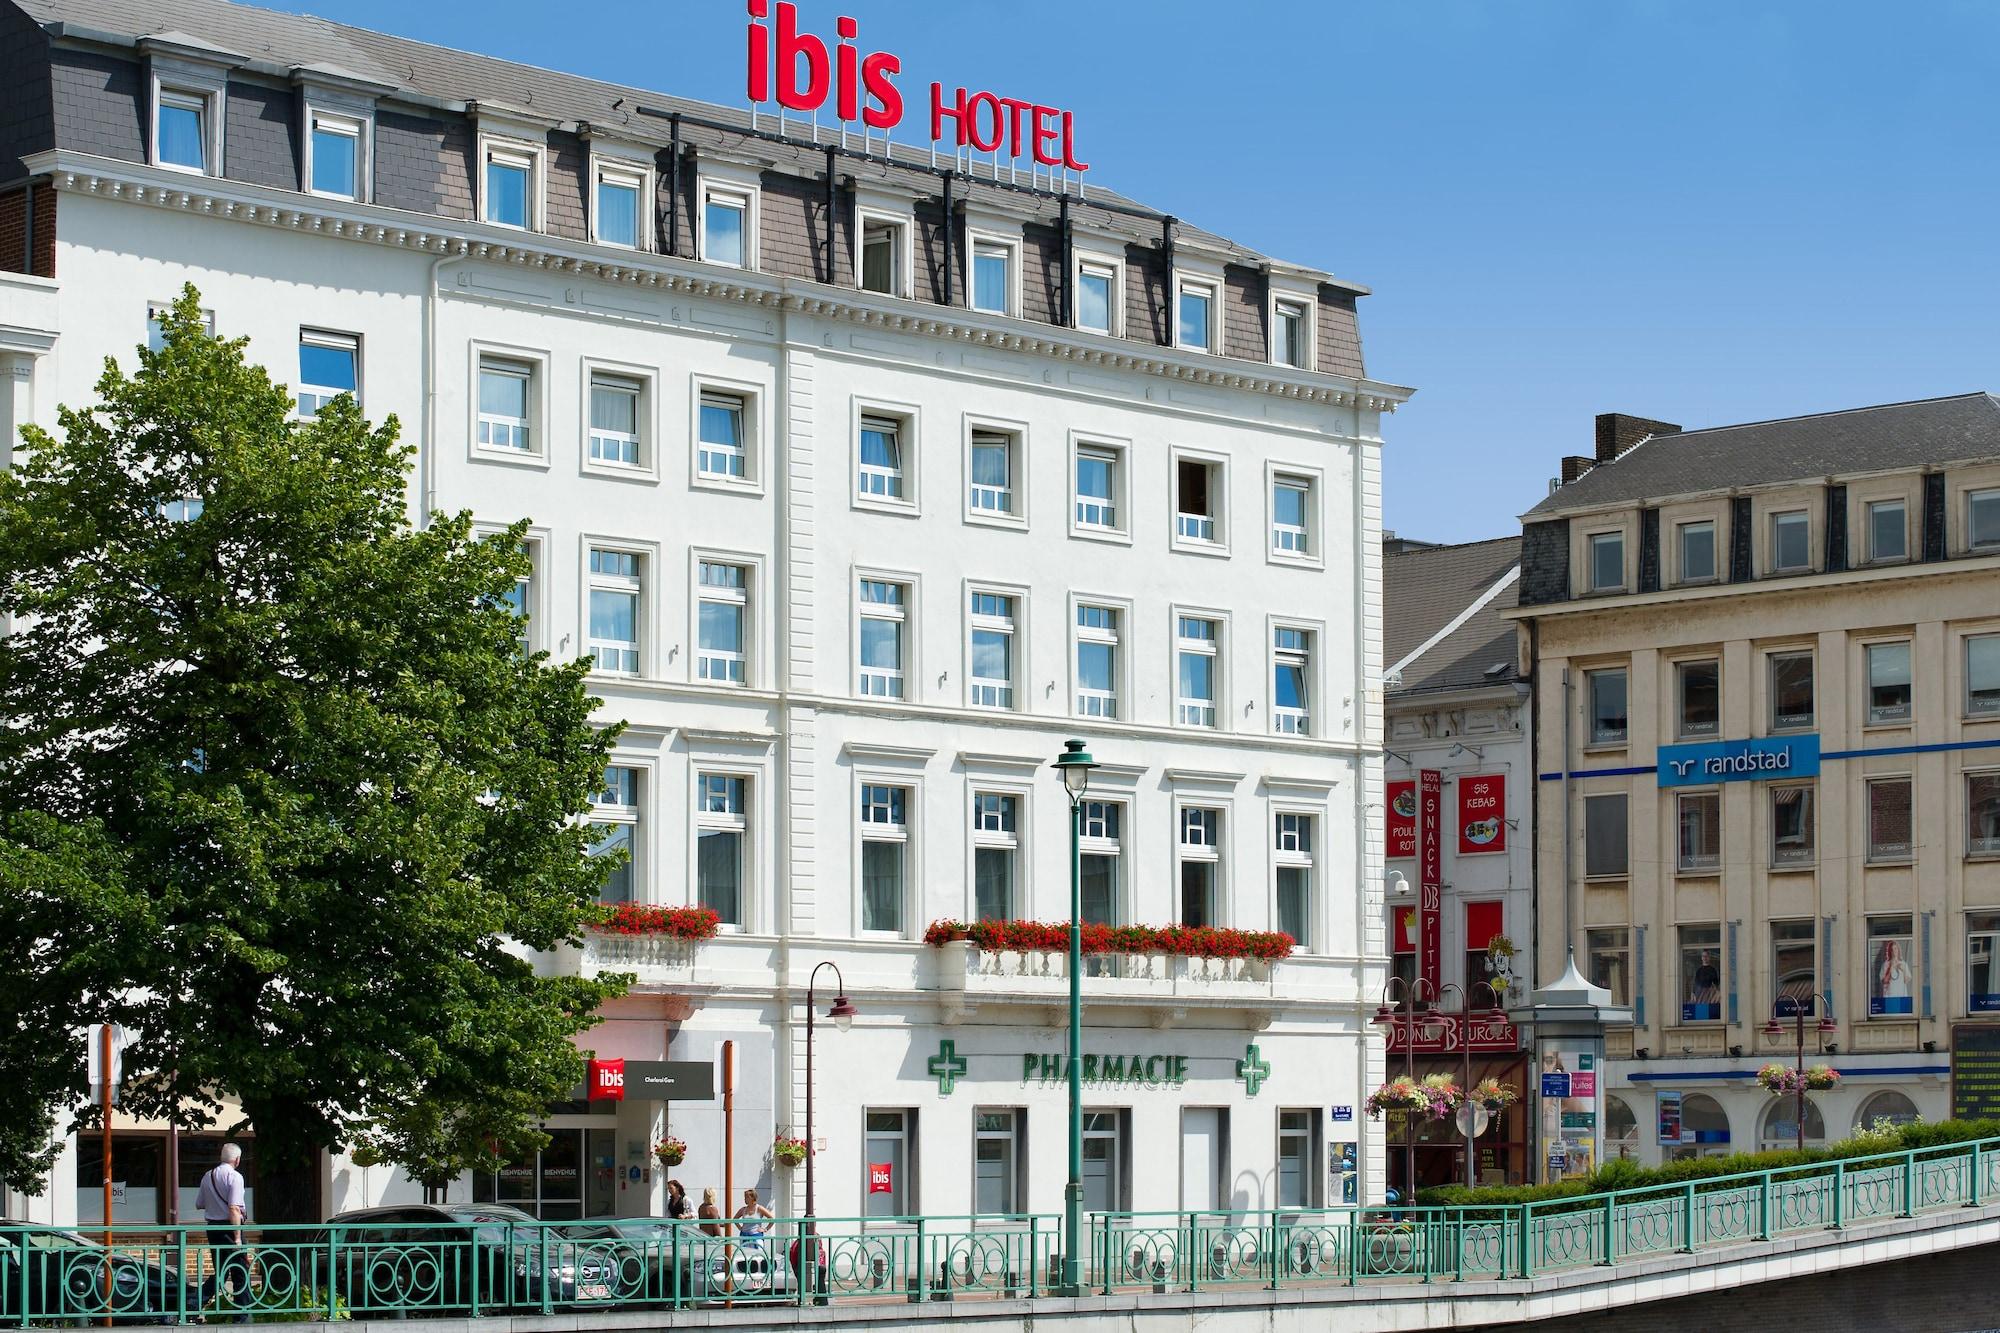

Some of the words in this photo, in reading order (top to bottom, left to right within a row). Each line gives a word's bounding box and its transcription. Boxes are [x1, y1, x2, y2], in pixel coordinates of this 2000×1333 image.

[747, 0, 904, 129] ibis
[930, 81, 1090, 172] HOTEL
[1704, 744, 1791, 775] randstad
[1423, 773, 1438, 782] 100%
[1421, 783, 1440, 793] HELAL
[1466, 796, 1496, 809] KEBAB
[1426, 798, 1435, 879] SNACK
[1423, 885, 1439, 909] DB
[599, 1068, 624, 1087] ibis
[872, 1170, 890, 1184] ibis
[112, 1187, 124, 1197] bis
